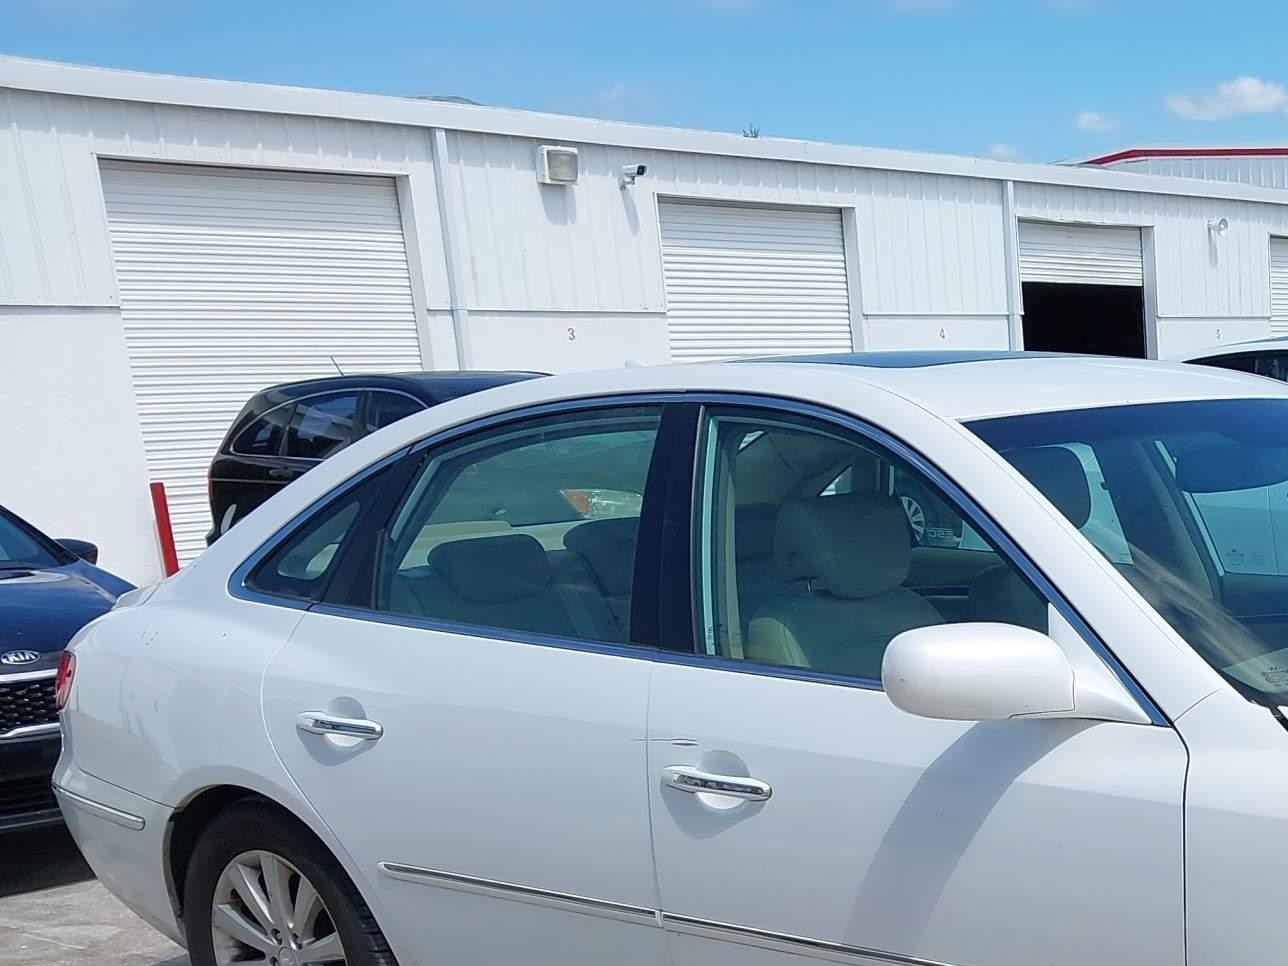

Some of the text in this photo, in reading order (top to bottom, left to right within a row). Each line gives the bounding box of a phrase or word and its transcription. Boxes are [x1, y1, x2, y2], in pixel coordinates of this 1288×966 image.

[567, 327, 576, 341] 3
[939, 327, 945, 340] 4
[8, 651, 37, 662] KIA
